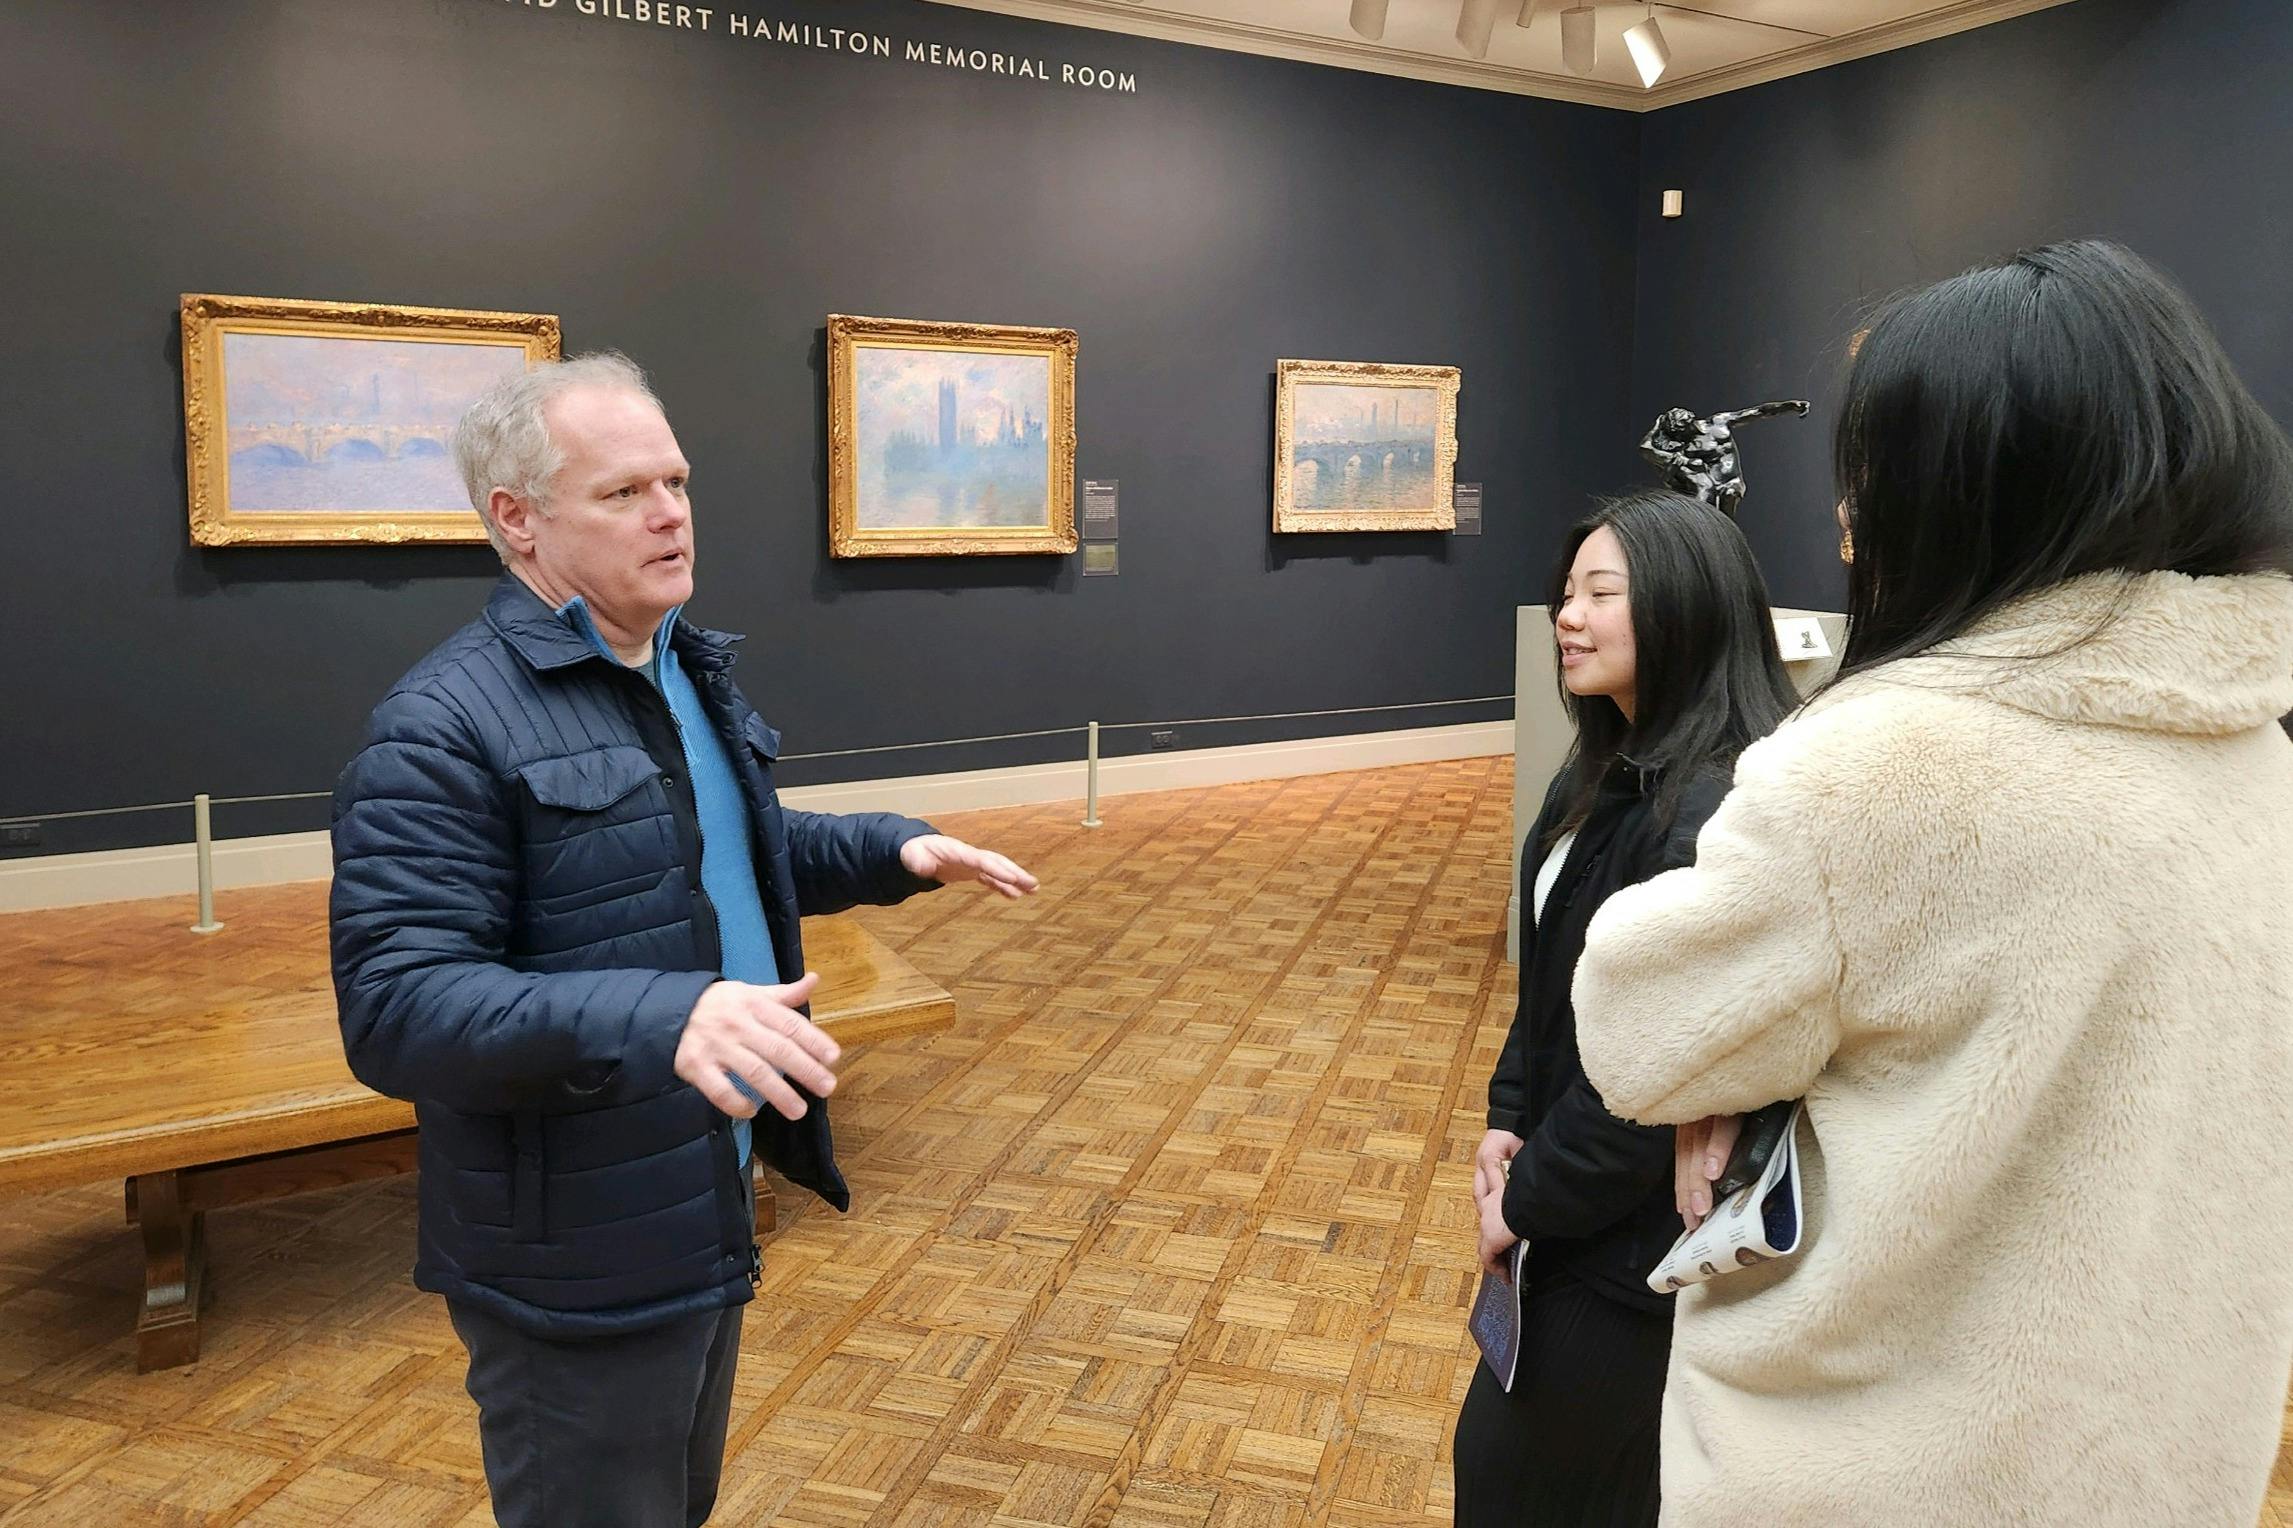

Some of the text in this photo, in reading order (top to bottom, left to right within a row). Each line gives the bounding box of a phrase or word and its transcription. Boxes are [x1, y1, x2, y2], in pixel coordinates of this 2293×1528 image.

[575, 0, 1136, 93] GILBERT HAMILTON MEMORIAL ROOM
